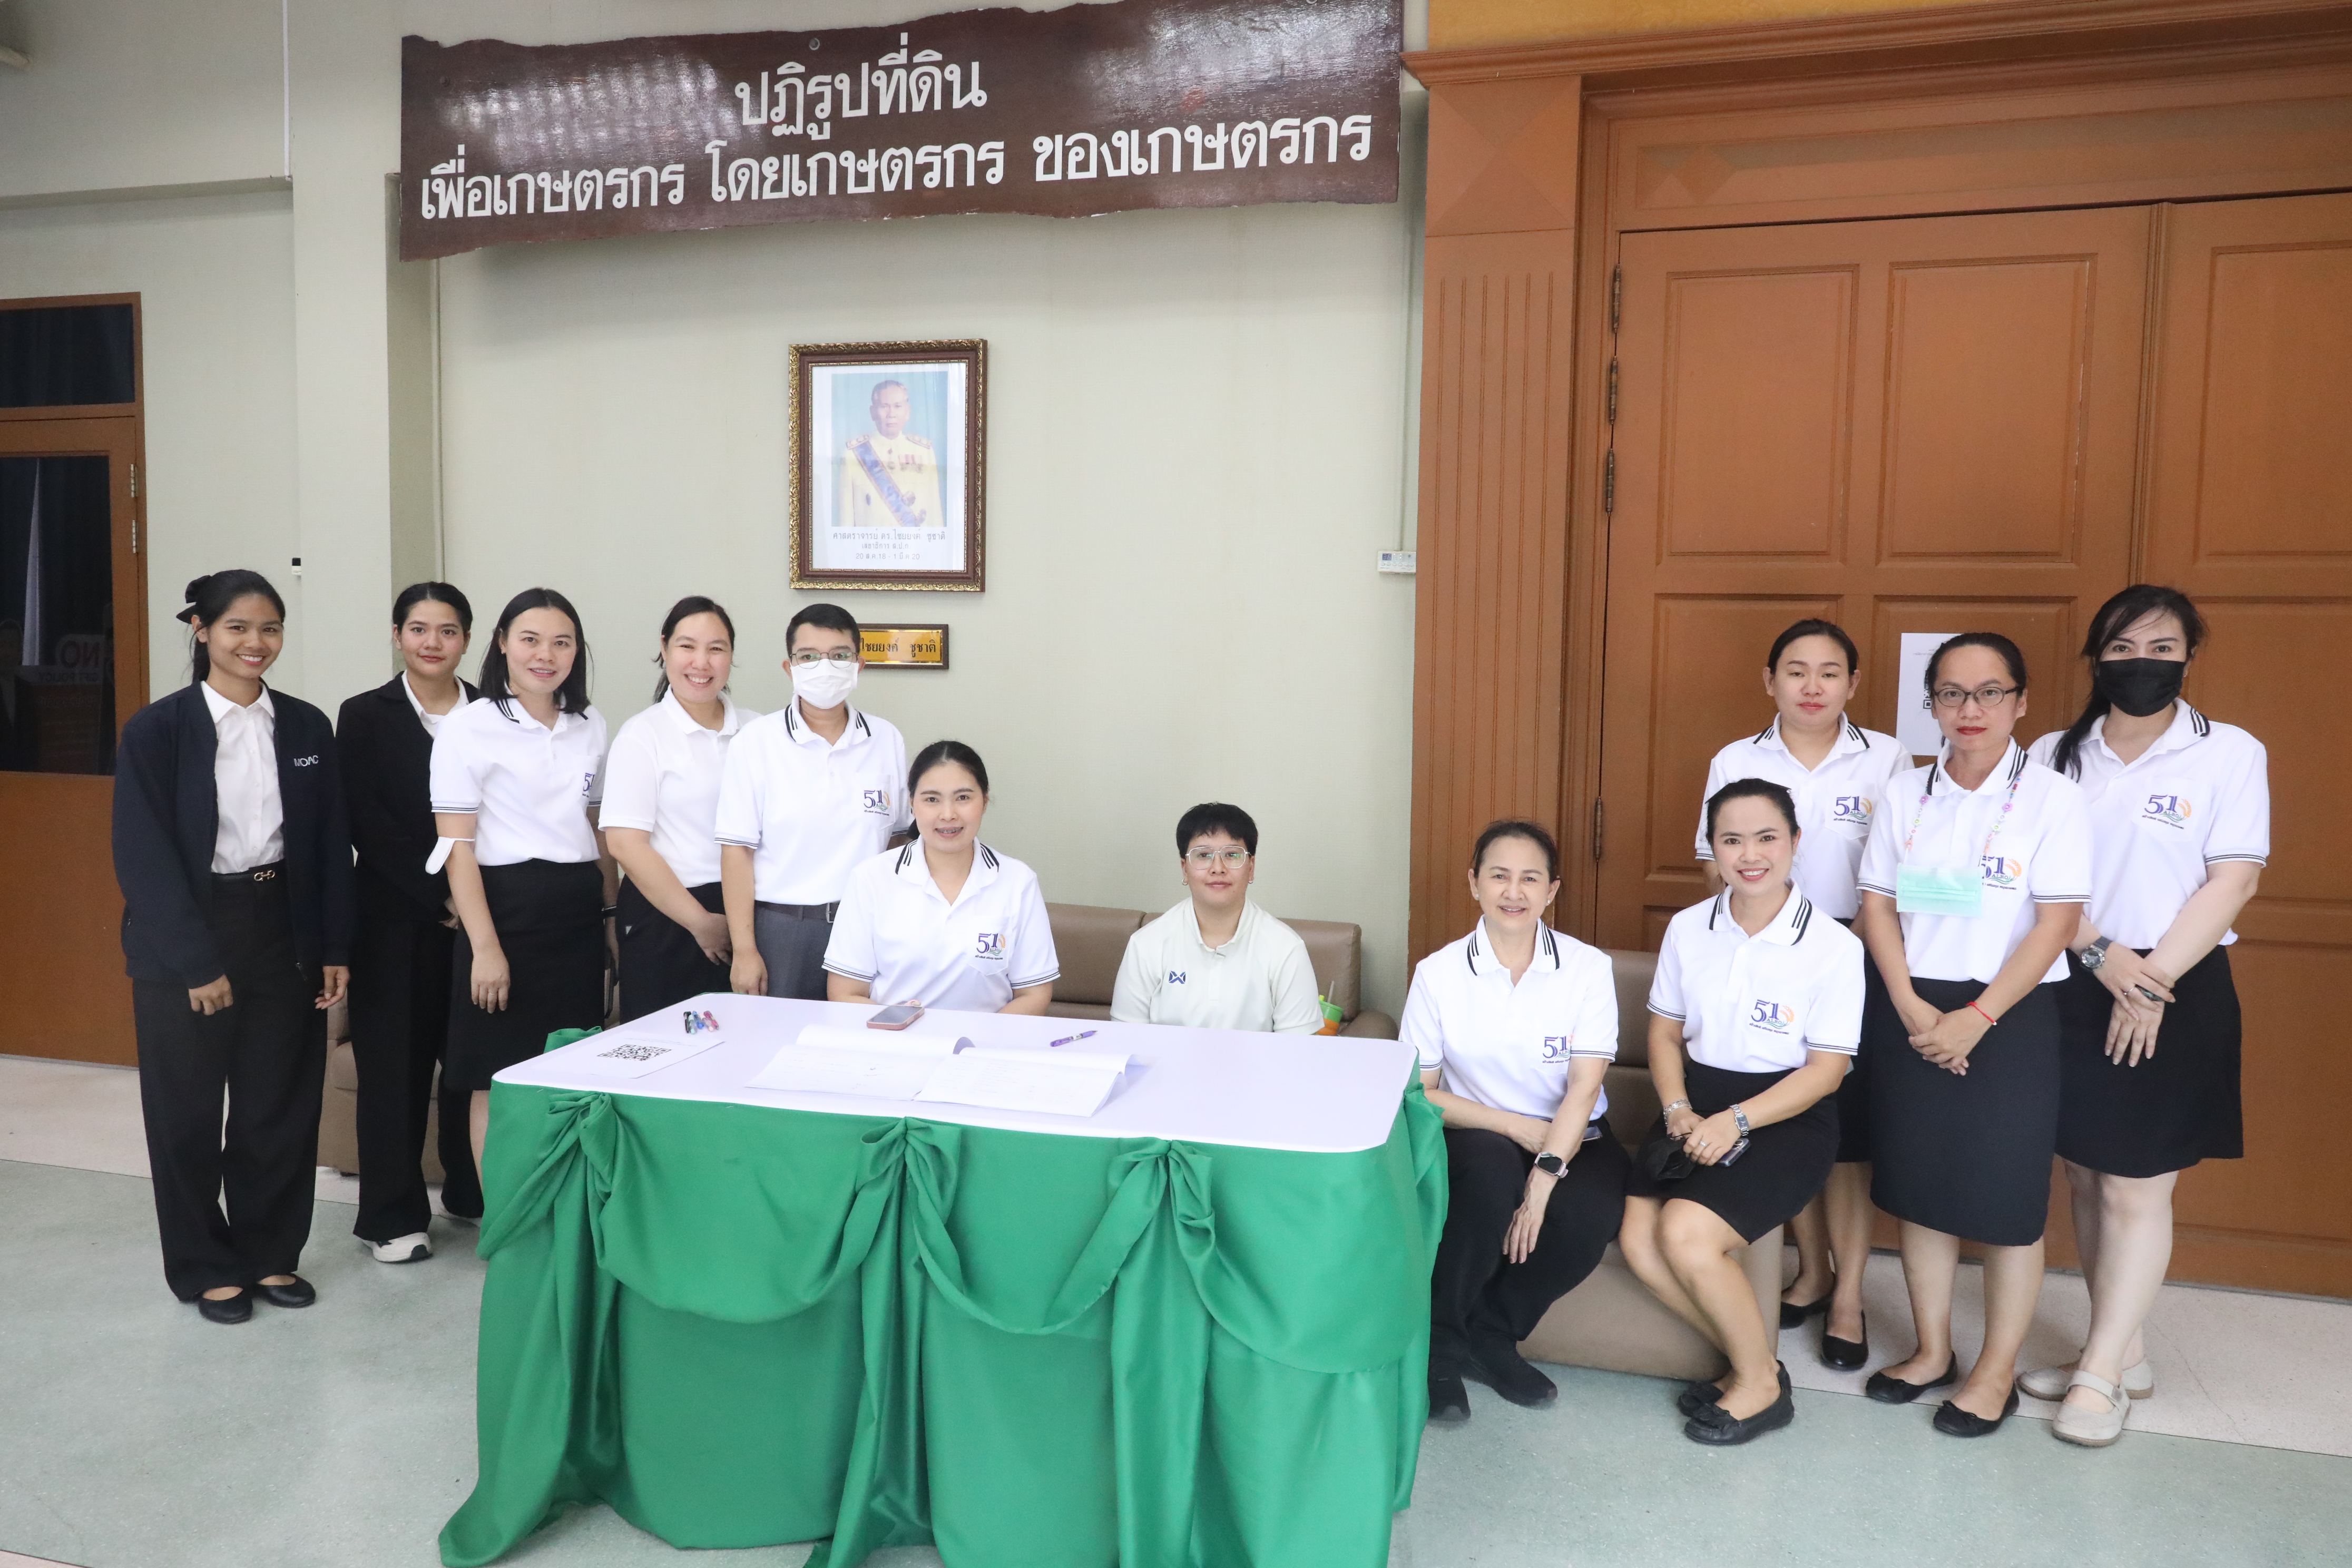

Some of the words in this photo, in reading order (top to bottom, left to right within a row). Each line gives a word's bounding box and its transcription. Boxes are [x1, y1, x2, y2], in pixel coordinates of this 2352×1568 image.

[734, 34, 987, 140] ปฏิรูปที่ดิน
[422, 144, 684, 220] เพื่อเกษตรกร
[705, 140, 1004, 202] โดยเกษตรกร
[1033, 114, 1372, 182] ของเกษตรกร
[833, 528, 878, 540] ศาสตราจารย์
[927, 531, 946, 543] ชูชาติ
[909, 639, 936, 658] ชูชาติ
[294, 755, 319, 767] MOAC
[864, 790, 884, 808] 51
[1834, 796, 1861, 816] 51
[2144, 795, 2178, 814] 51
[976, 933, 998, 954] 51
[1751, 999, 1780, 1022] 51
[1543, 1035, 1568, 1059] 51
